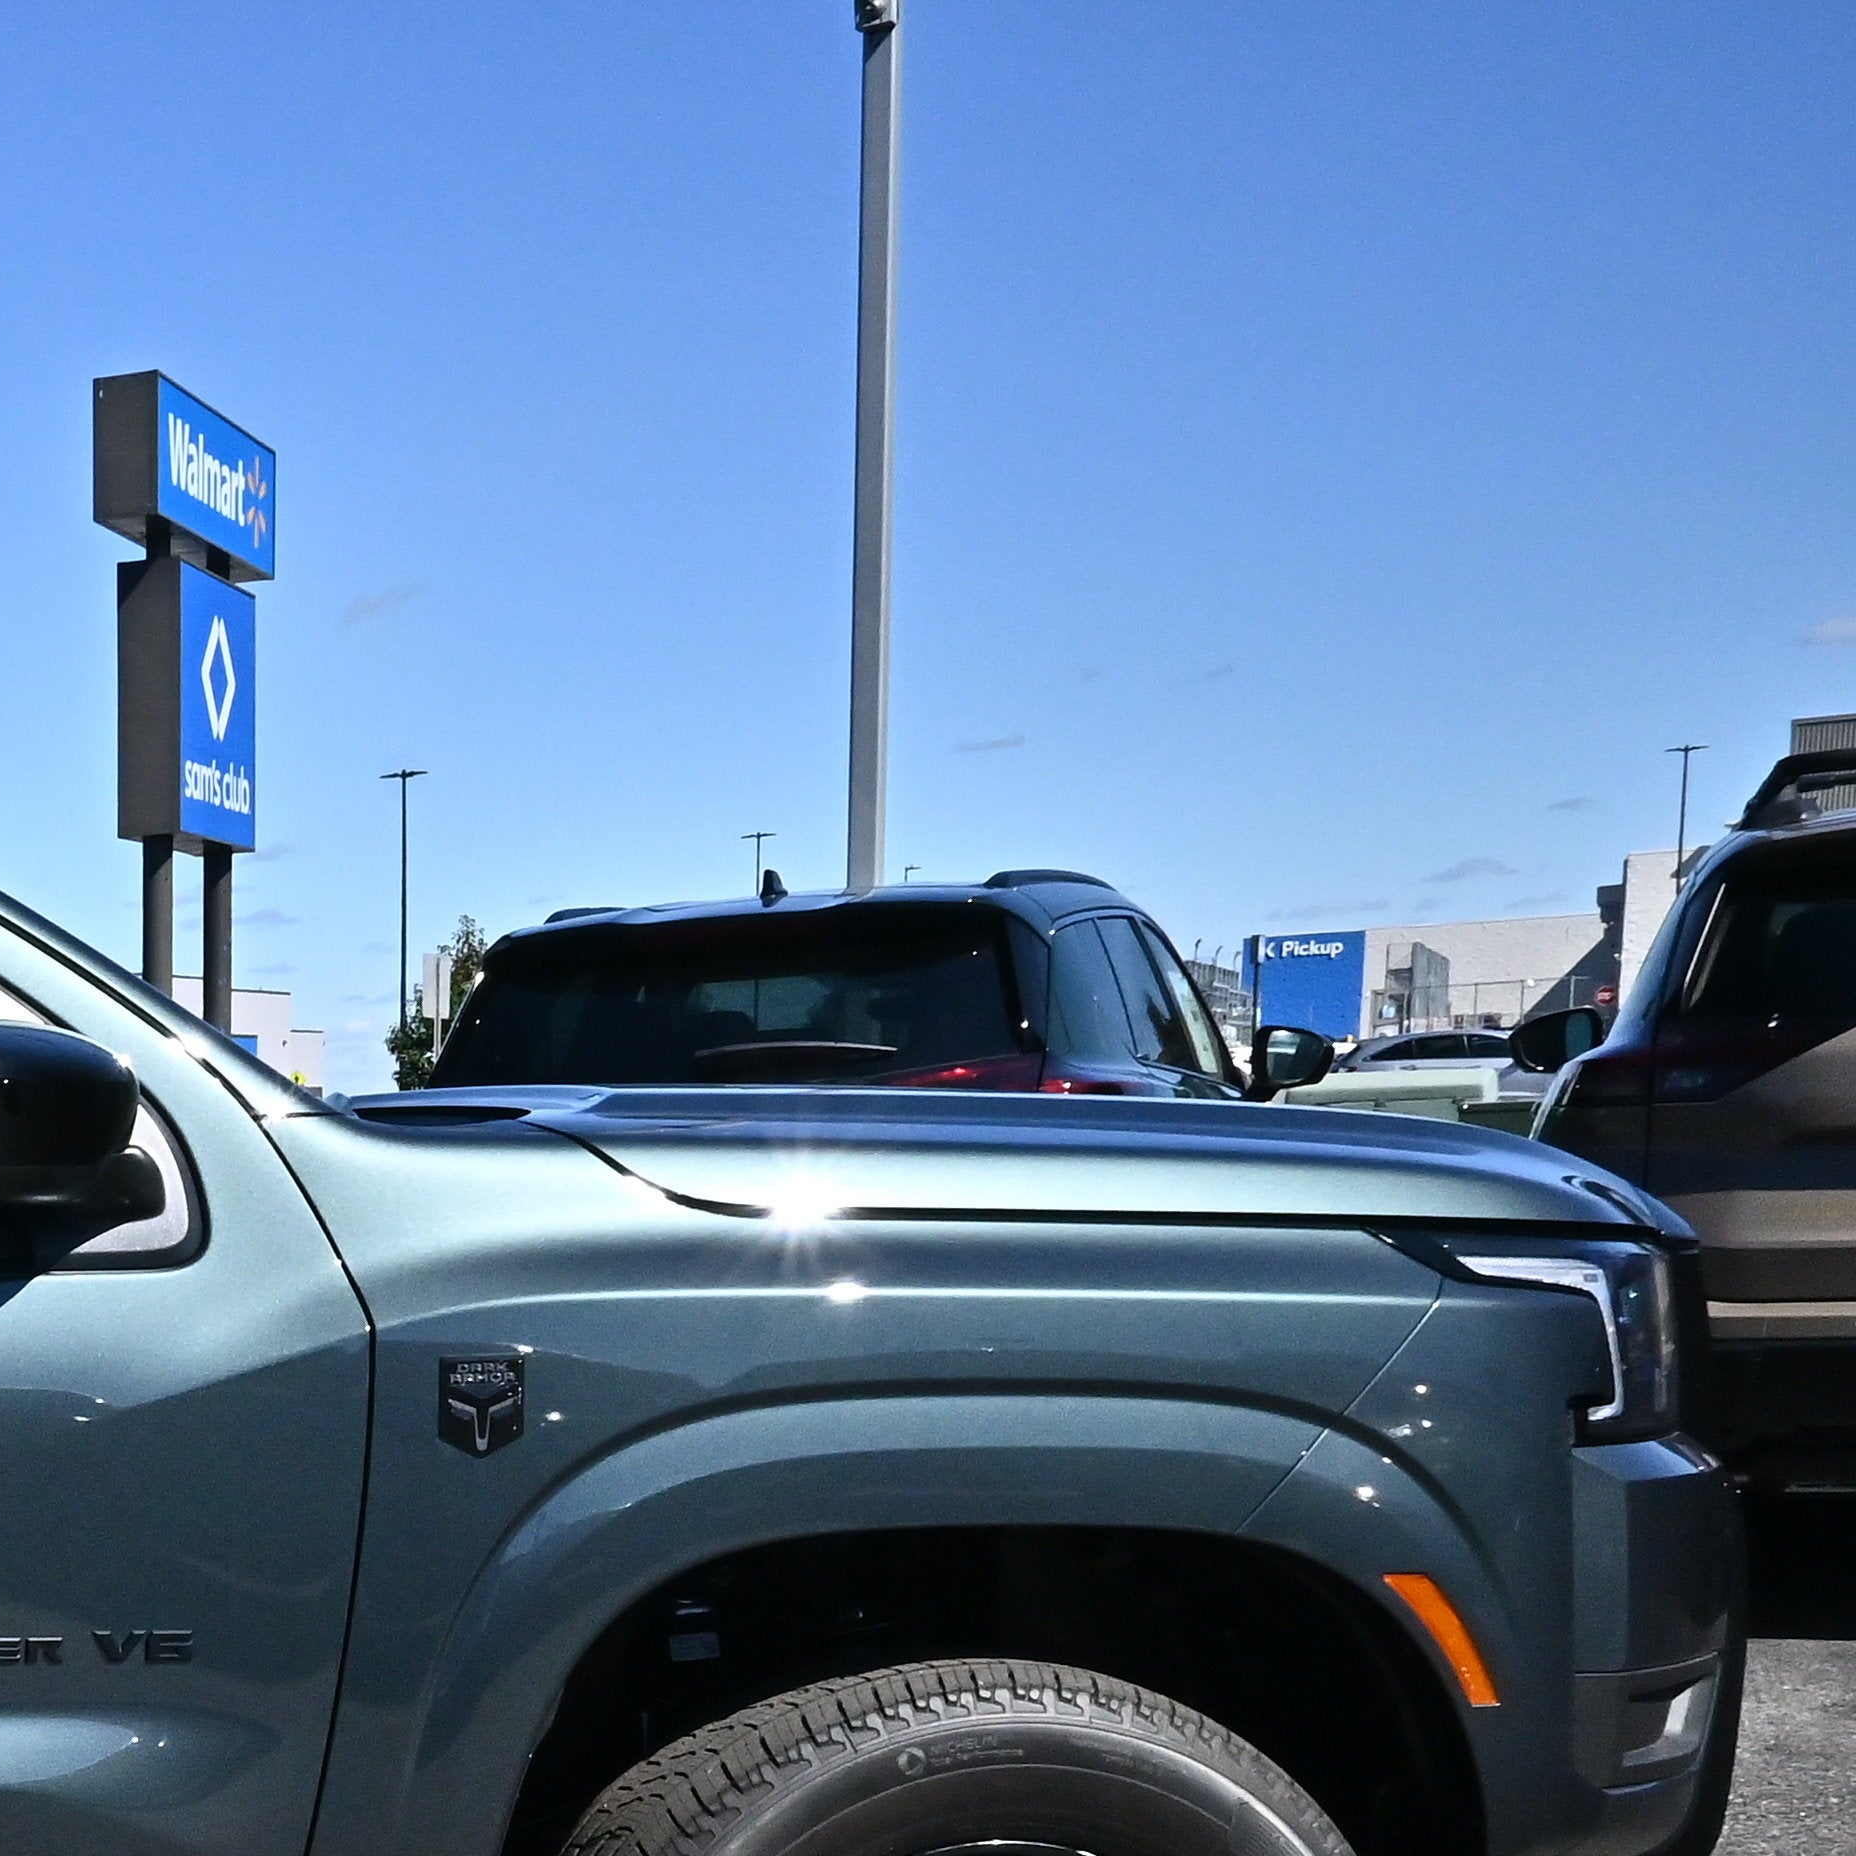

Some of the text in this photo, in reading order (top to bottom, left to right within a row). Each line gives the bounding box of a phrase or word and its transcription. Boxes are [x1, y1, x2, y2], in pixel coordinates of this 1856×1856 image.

[168, 412, 246, 527] Walmart
[185, 758, 249, 815] sam's club
[1282, 940, 1344, 958] Pickup
[449, 1372, 515, 1385] ARMOR
[456, 1361, 509, 1374] DARK
[92, 1629, 193, 1663] V6
